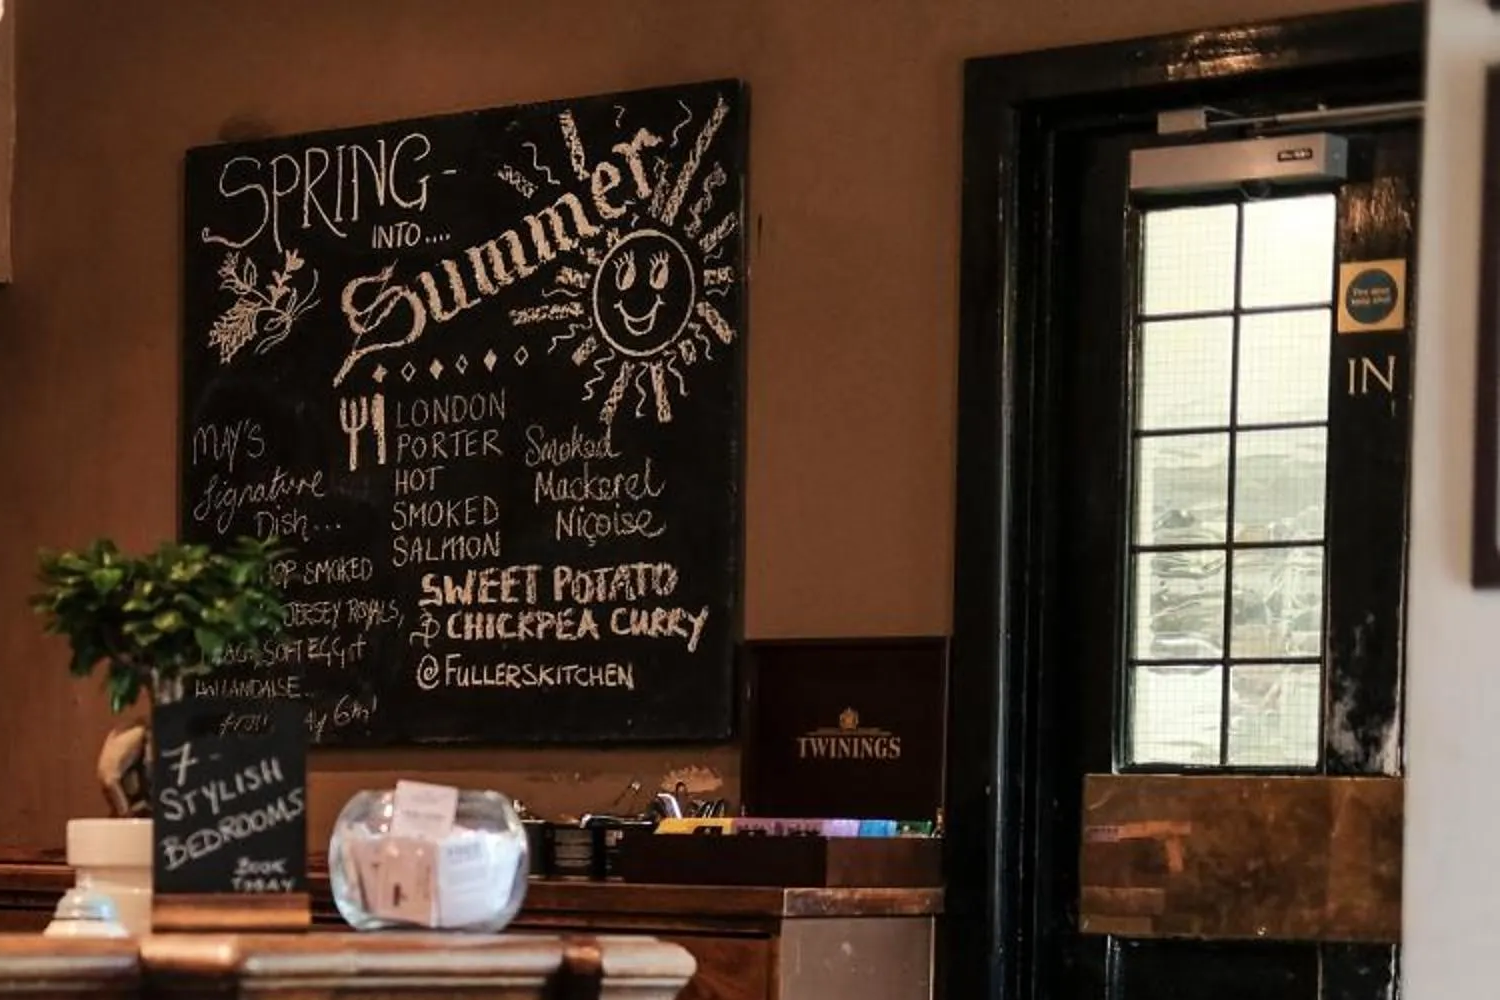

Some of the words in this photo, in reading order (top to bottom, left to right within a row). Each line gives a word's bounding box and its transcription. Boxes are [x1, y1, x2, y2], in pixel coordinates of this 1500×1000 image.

[333, 127, 664, 387] Summer
[1348, 356, 1396, 395] IN
[396, 388, 506, 428] LONDON
[397, 429, 502, 463] PORTER
[525, 424, 623, 467] Smoked
[395, 466, 445, 496] HOT
[534, 457, 666, 505] Mackerel
[391, 496, 500, 531] SMOKED
[392, 531, 500, 567] SALMON
[303, 556, 373, 585] SMOKED
[418, 565, 542, 606] SWEET
[553, 562, 678, 604] POTATO
[447, 608, 600, 641] CHICKPEA
[610, 605, 709, 653] CURRY
[416, 653, 635, 690] @FULLERSKITCHEN
[162, 742, 198, 787] 7
[796, 736, 901, 759] TWININGS
[160, 757, 284, 822] STYLISH
[161, 788, 304, 872] BEDROOMS
